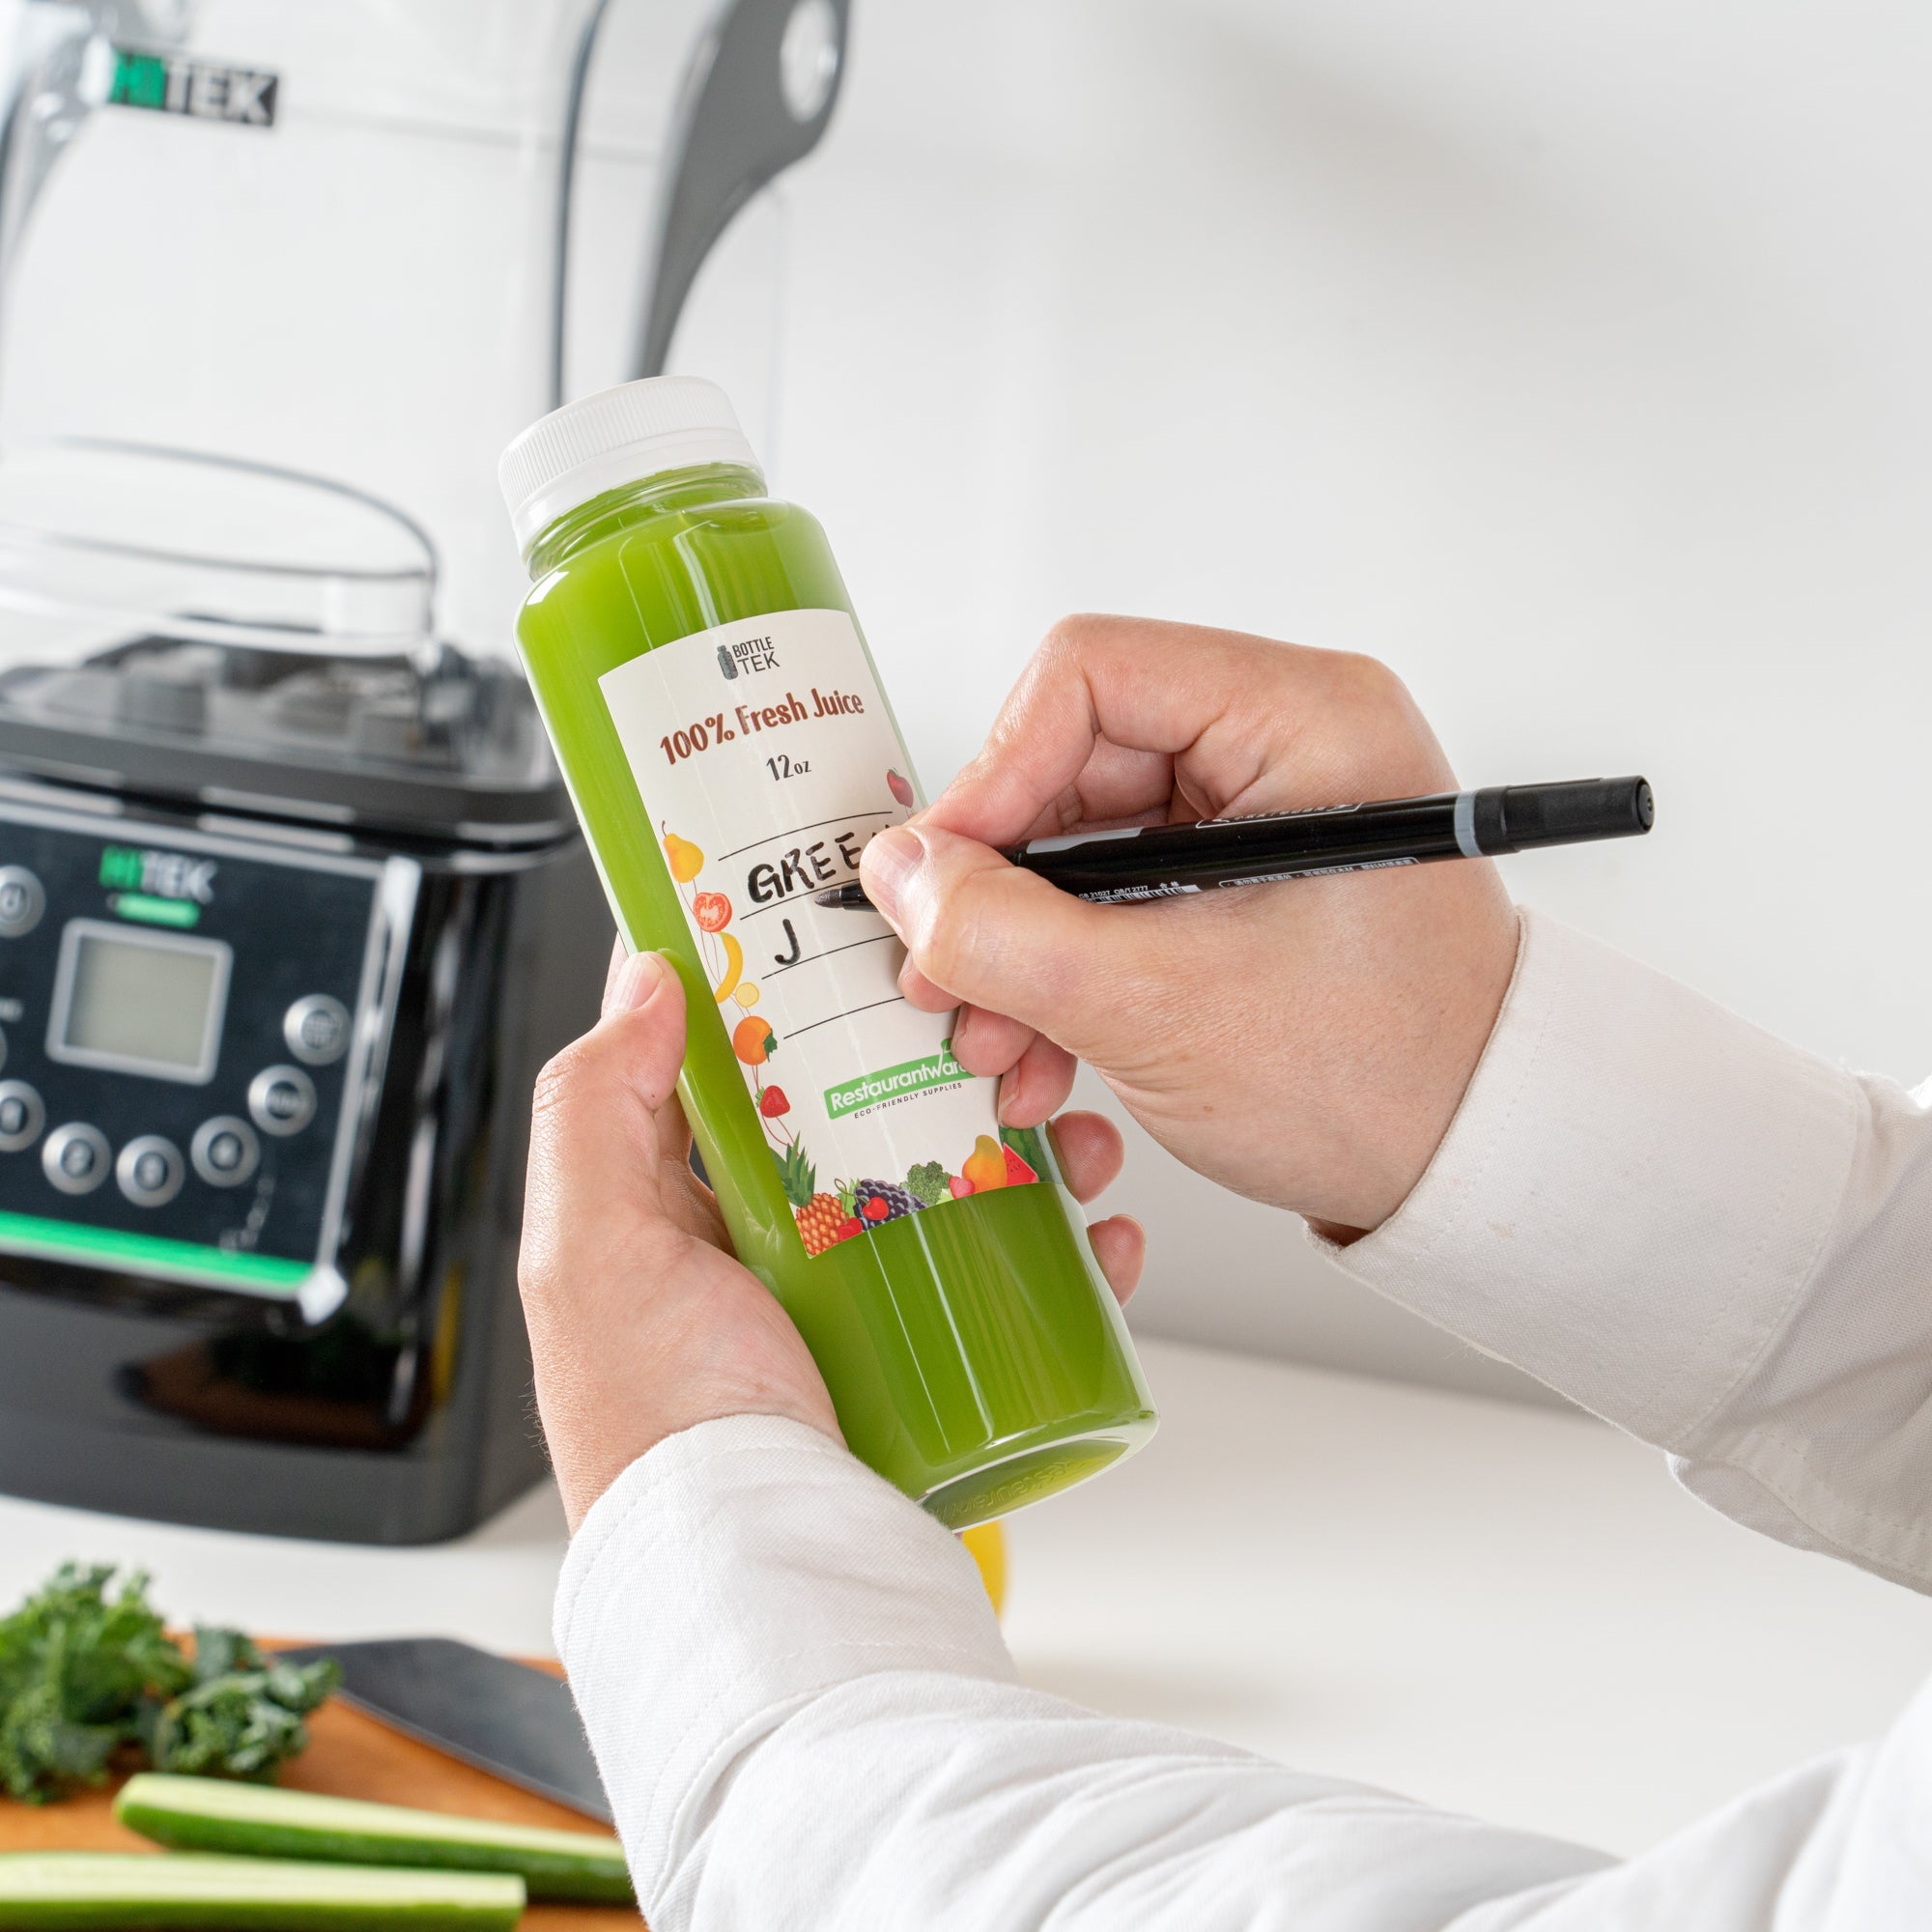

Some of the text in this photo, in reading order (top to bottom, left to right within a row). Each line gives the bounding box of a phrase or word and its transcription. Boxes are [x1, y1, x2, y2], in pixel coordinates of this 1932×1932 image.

[732, 637, 775, 658] BOTTLE
[737, 651, 781, 674] TEK
[660, 688, 865, 765] 100% Fresh Juice
[748, 824, 890, 903] GREE
[775, 919, 801, 965] J
[854, 1082, 962, 1119] ECO-FRIENDLY SUPPLIES
